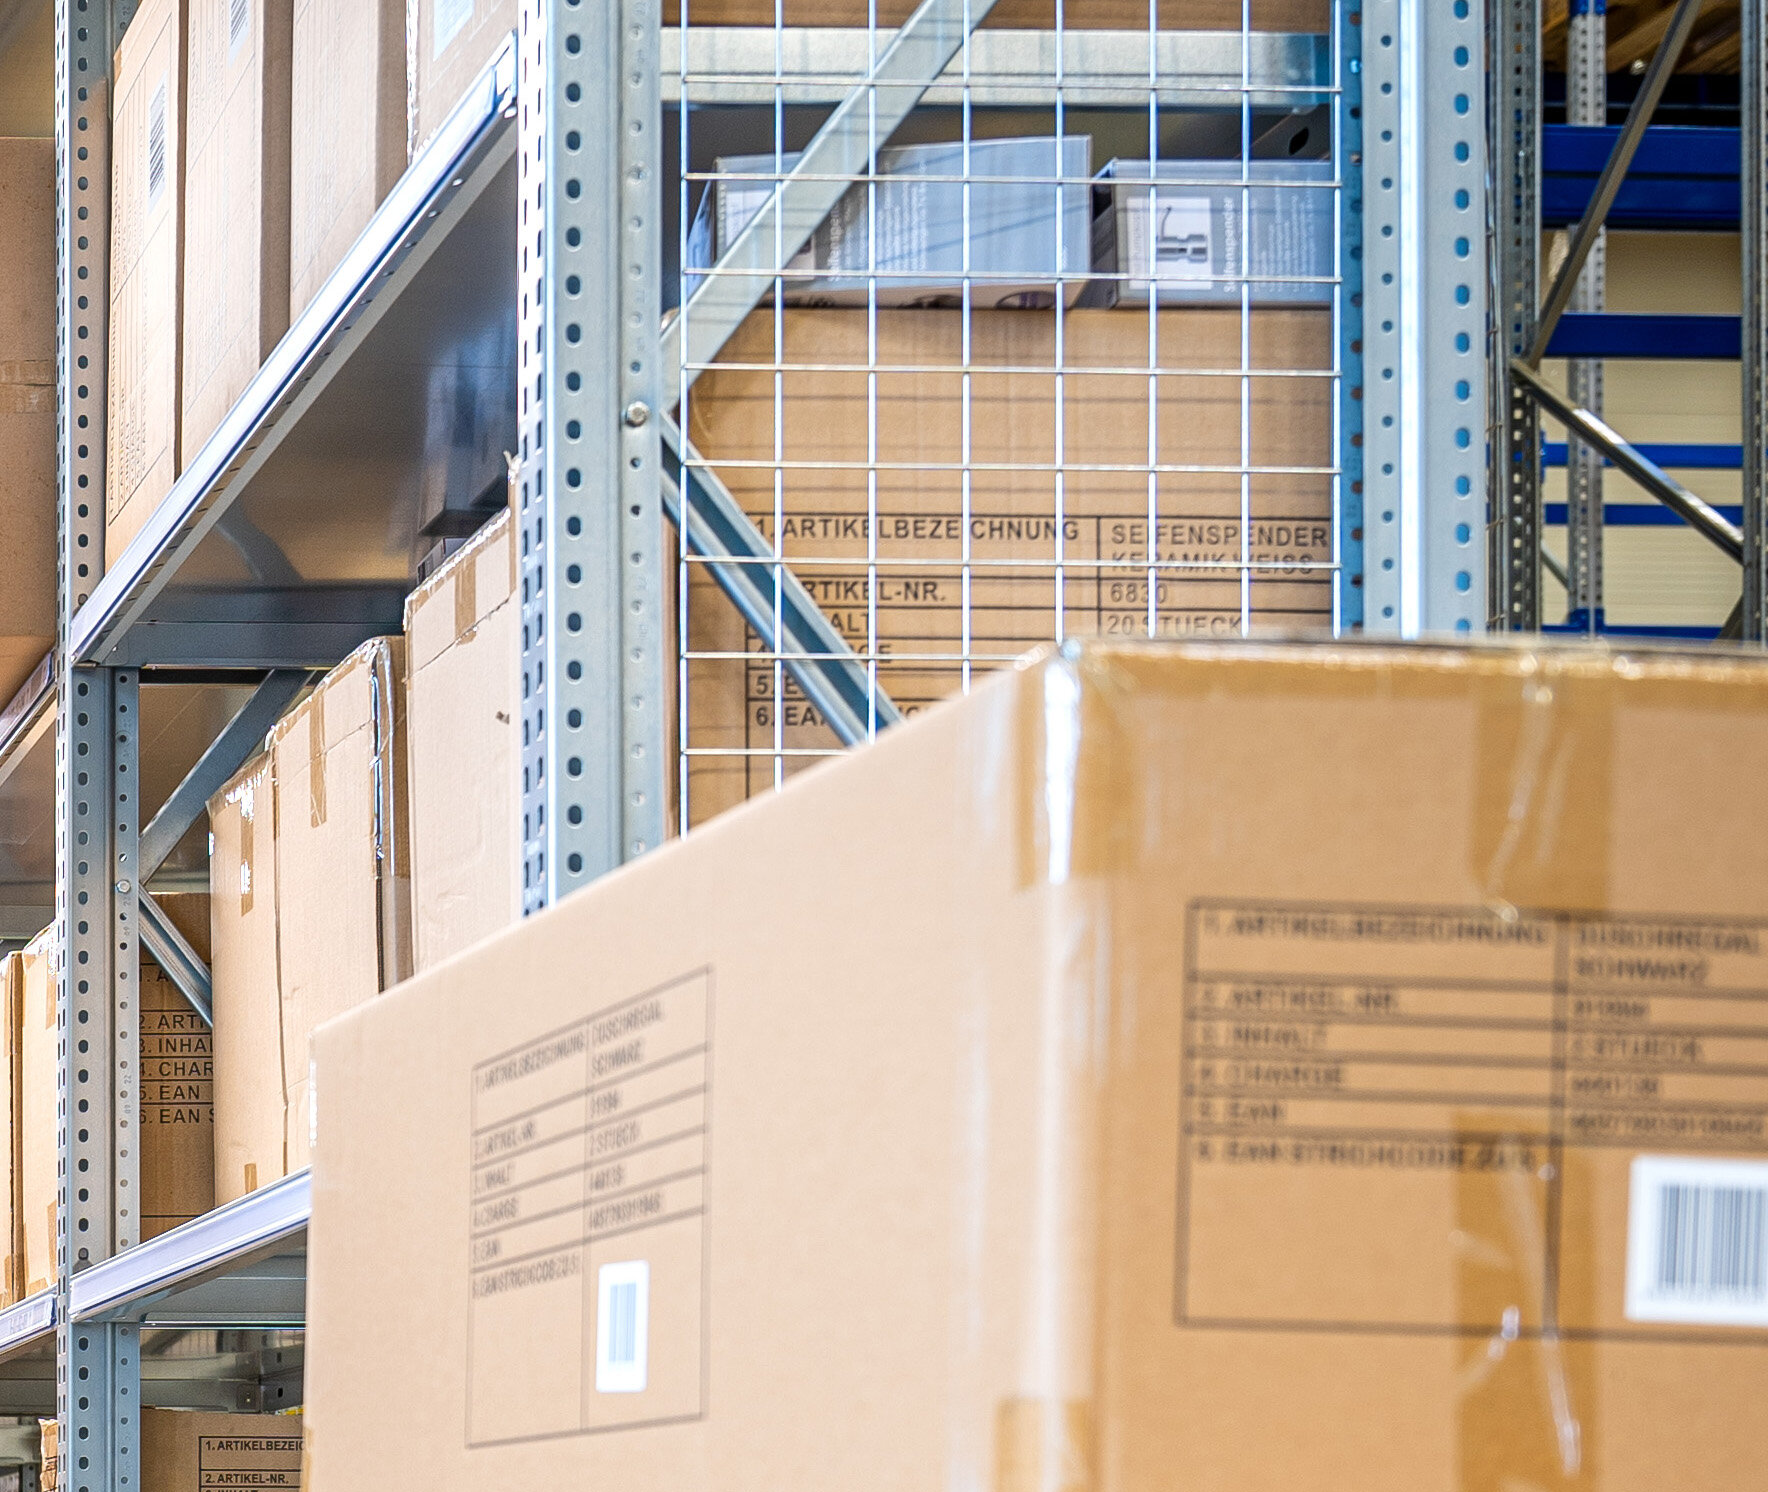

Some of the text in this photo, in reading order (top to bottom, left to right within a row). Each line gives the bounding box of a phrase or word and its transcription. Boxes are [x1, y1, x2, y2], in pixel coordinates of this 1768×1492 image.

[781, 518, 1080, 541] ARTIKELBEZECHNUNG
[1110, 523, 1329, 548] SEFENSPENDER
[800, 580, 946, 603] RTIKEL-NR.
[159, 1085, 200, 1101] EAN
[159, 1108, 200, 1125] EAN
[205, 1440, 216, 1451] 1.
[205, 1473, 289, 1485] 2. ARTIKEL-NR.
